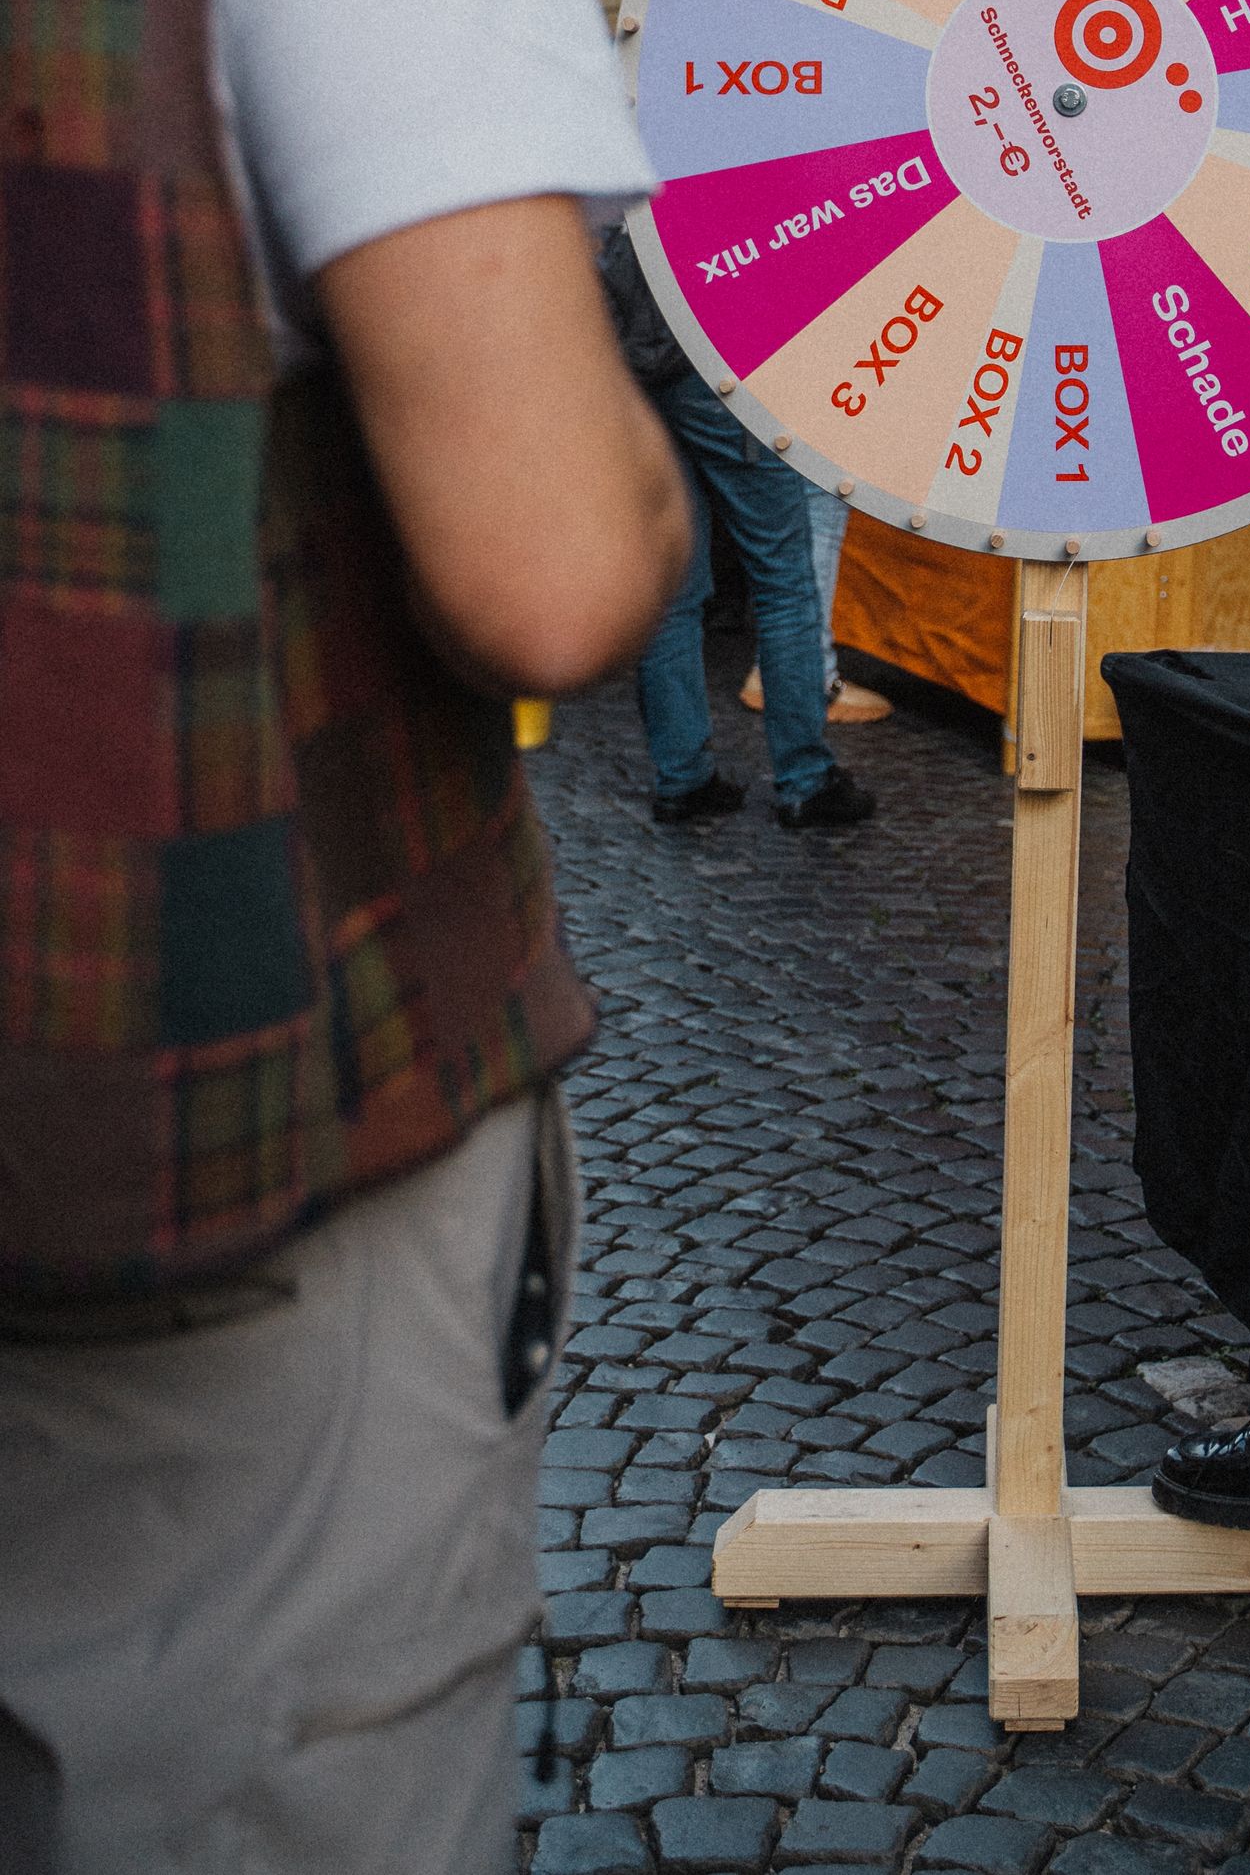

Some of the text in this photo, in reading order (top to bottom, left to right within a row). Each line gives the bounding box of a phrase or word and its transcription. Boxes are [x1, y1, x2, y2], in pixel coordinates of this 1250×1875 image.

[686, 61, 821, 94] BOX 1
[980, 6, 1092, 220] Schneckenvorstadt
[696, 156, 932, 284] Das war nix
[831, 285, 944, 417] BOX 3
[946, 329, 1022, 476] BOX 2
[1056, 345, 1089, 482] BOX 1
[1152, 284, 1249, 457] Schade
